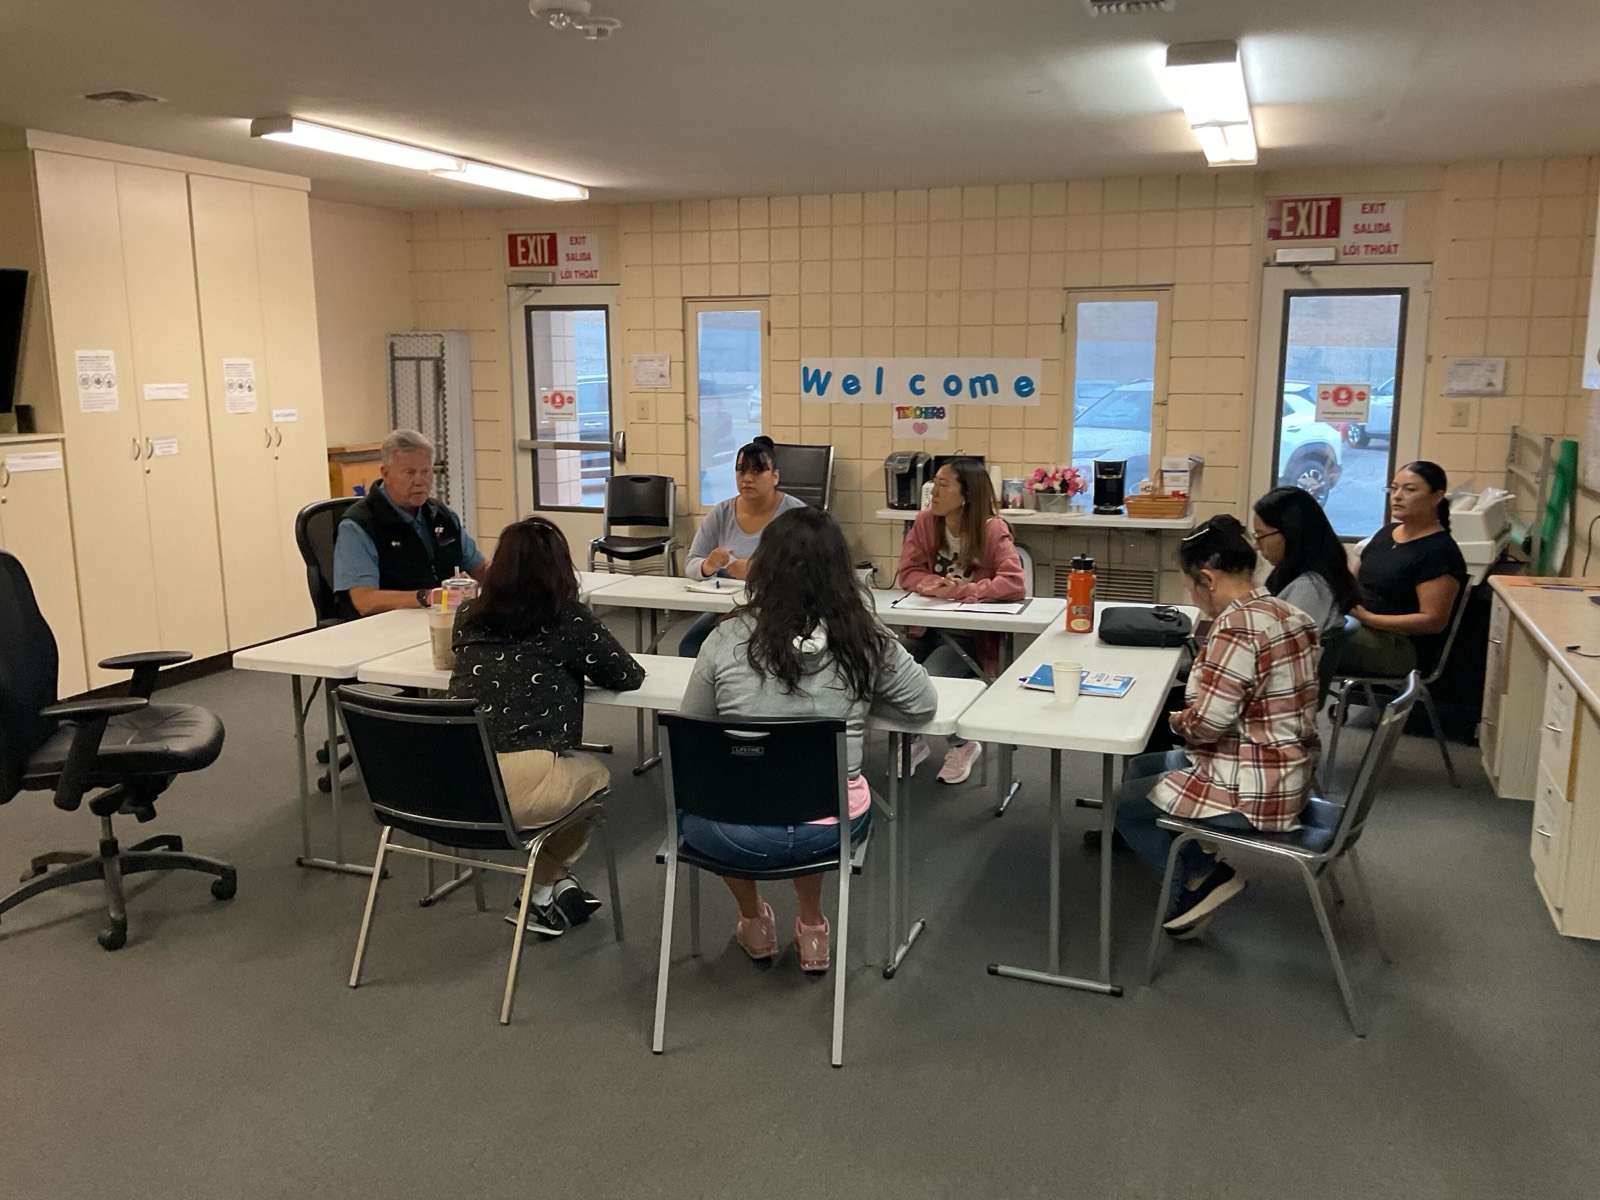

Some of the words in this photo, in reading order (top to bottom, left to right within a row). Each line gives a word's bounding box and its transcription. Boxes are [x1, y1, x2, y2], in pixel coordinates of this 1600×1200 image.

[1361, 203, 1385, 214] EXIT
[1281, 200, 1331, 236] EXIT
[1353, 223, 1391, 234] SALIDA
[569, 236, 586, 245] EXIT
[517, 235, 550, 264] EXIT
[565, 253, 592, 262] SALIDA
[802, 366, 1035, 398] Welcome
